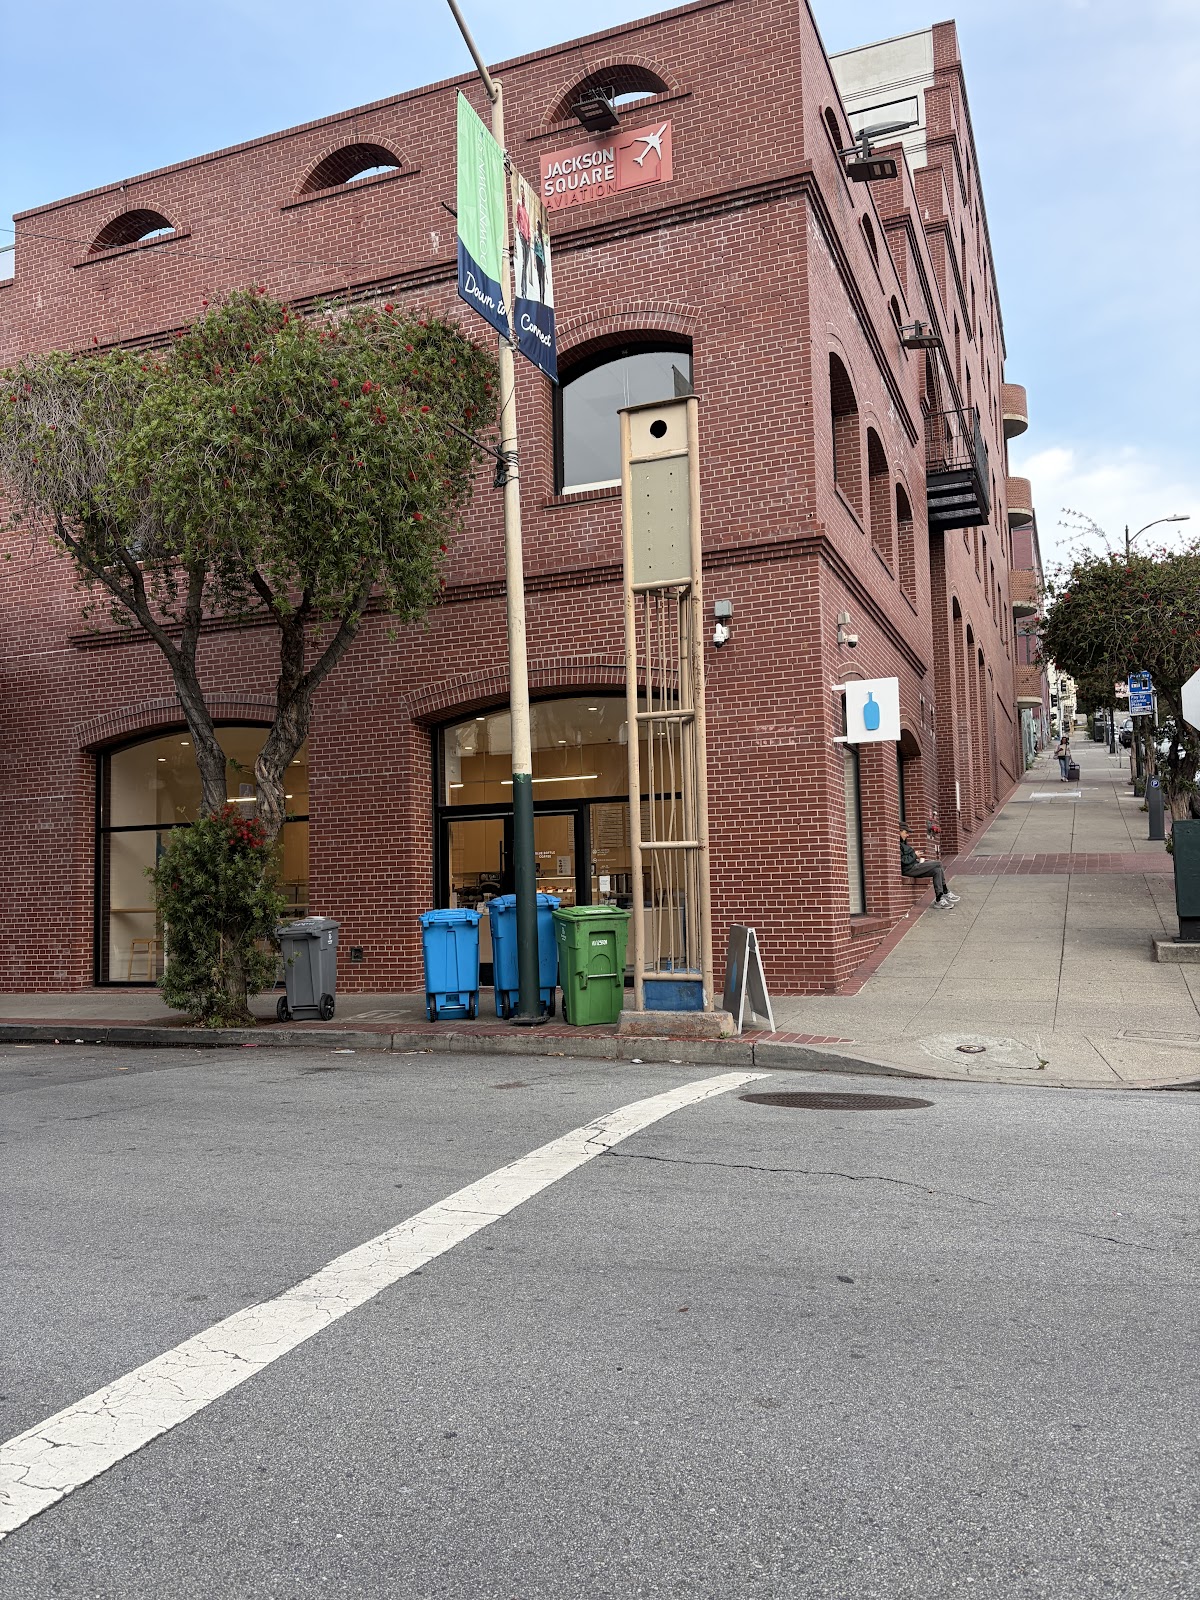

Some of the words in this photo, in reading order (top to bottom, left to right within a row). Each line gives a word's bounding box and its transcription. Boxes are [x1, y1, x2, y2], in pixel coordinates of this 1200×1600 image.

[544, 147, 614, 180] JACKSON
[544, 165, 615, 197] SQUARE
[546, 183, 617, 209] AVIATION
[478, 159, 488, 268] DOWNTOWN
[465, 271, 495, 308] Down
[497, 301, 506, 315] to
[520, 313, 552, 347] Connect
